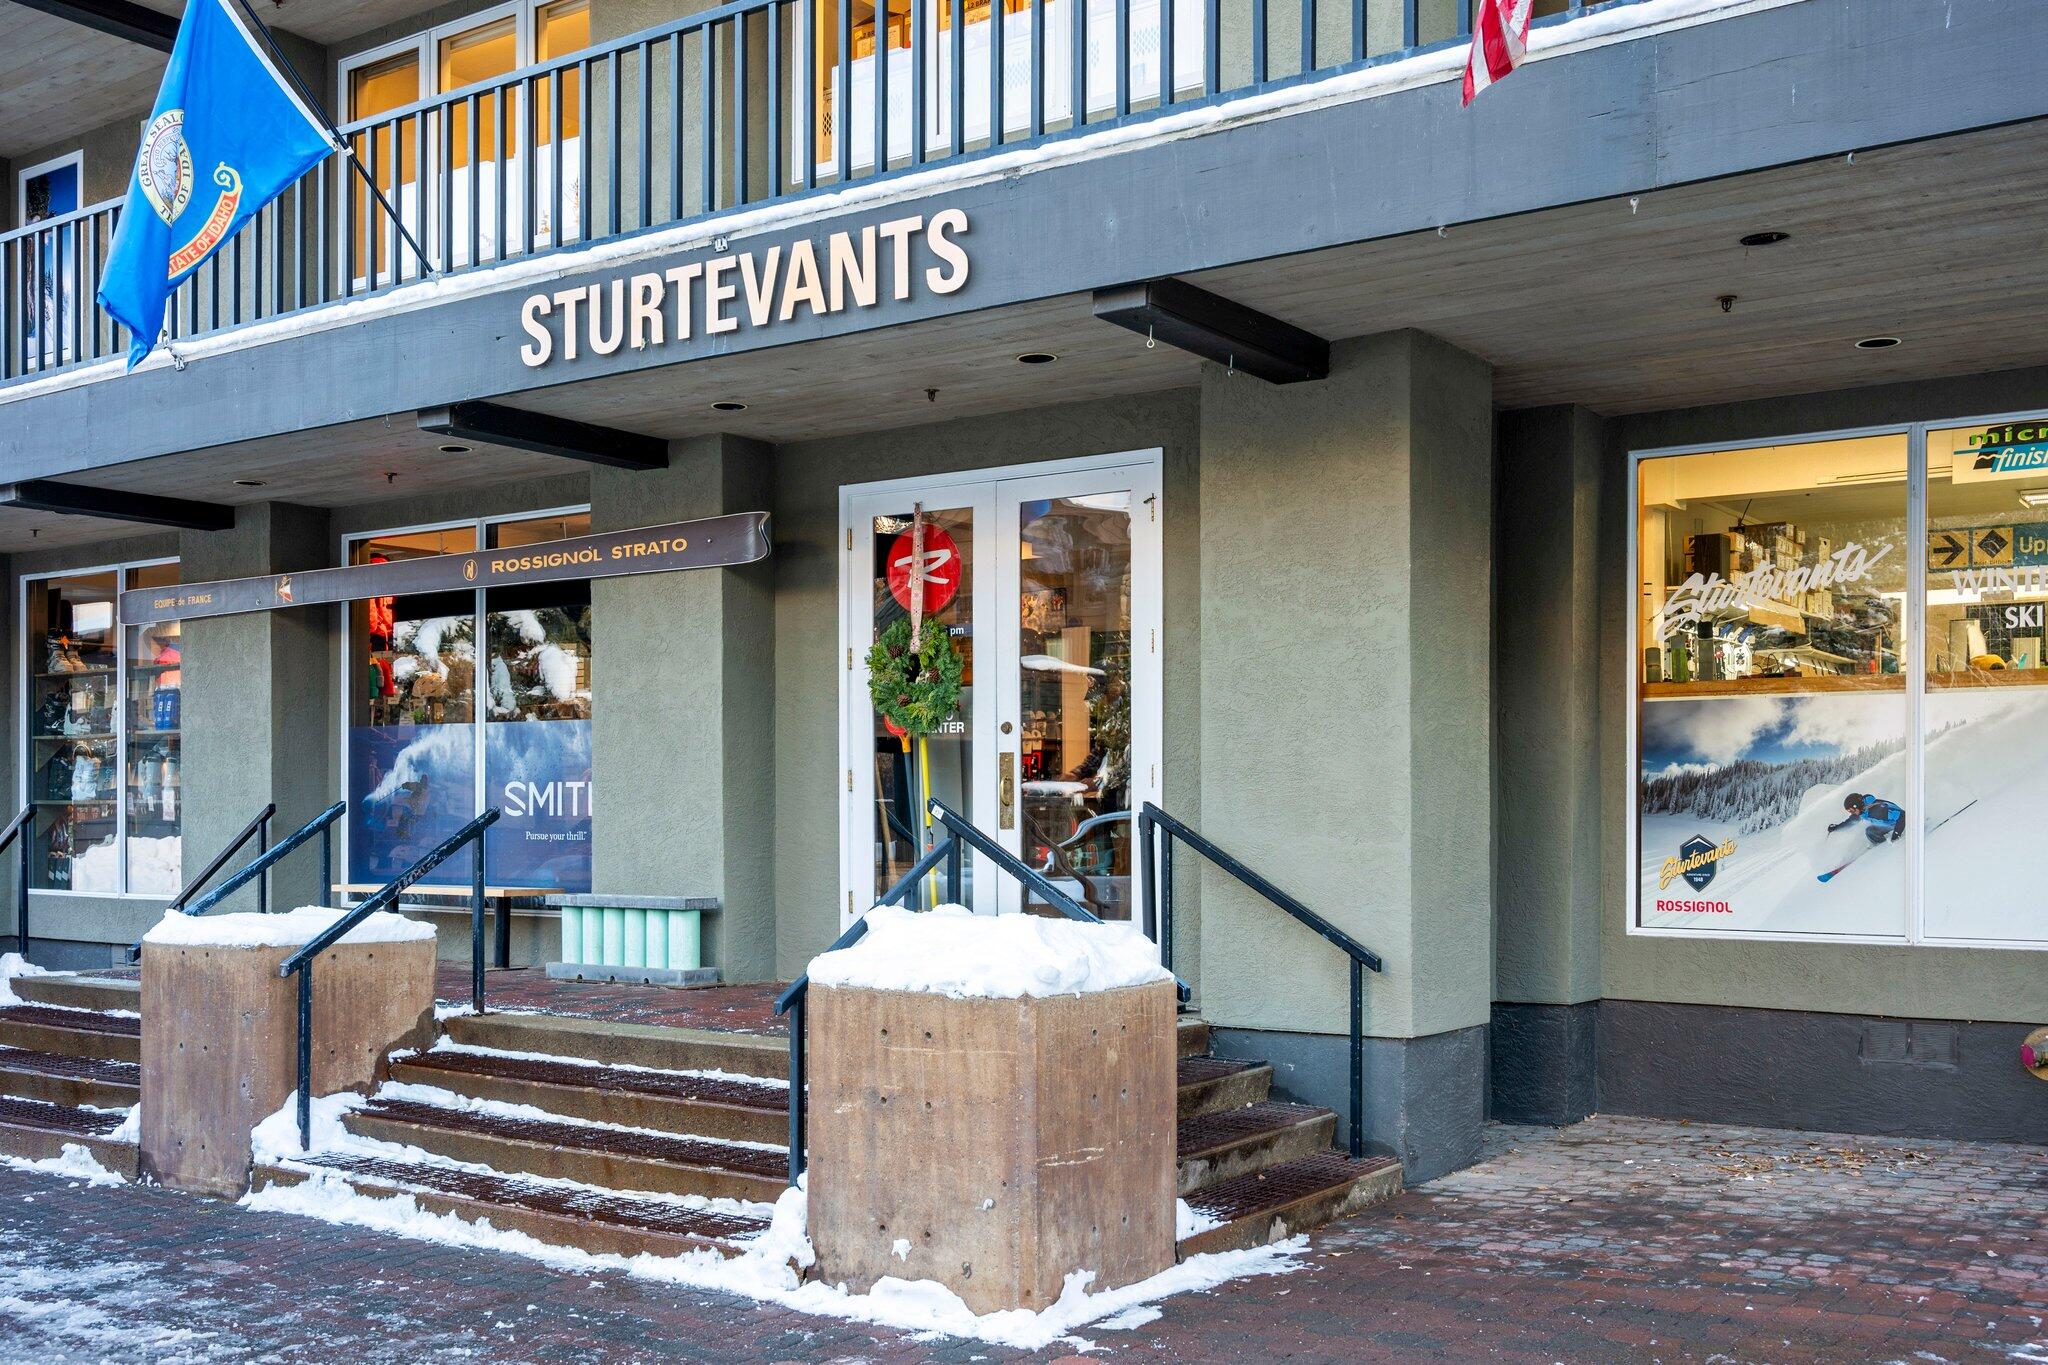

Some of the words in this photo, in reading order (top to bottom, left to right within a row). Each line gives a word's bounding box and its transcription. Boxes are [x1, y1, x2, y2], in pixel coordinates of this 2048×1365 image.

[140, 143, 152, 187] GREAT
[150, 113, 179, 138] SEAL
[177, 183, 188, 204] OF
[197, 232, 215, 252] OF
[208, 198, 235, 239] IDAHO
[519, 207, 970, 369] STURTEVANTS
[491, 549, 603, 574] ROSSIGNOL
[611, 538, 689, 560] STRATO
[154, 598, 175, 609] EQUIPE
[178, 597, 185, 606] de
[187, 594, 212, 605] FRANCE
[1656, 541, 1894, 641] Sturtevants
[950, 627, 964, 637] pm
[2005, 605, 2043, 629] SKI
[525, 831, 548, 841] Pursue
[549, 832, 566, 843] your
[1659, 837, 1737, 890] Sturtevants
[1656, 900, 1733, 914] ROSSIGNOL
